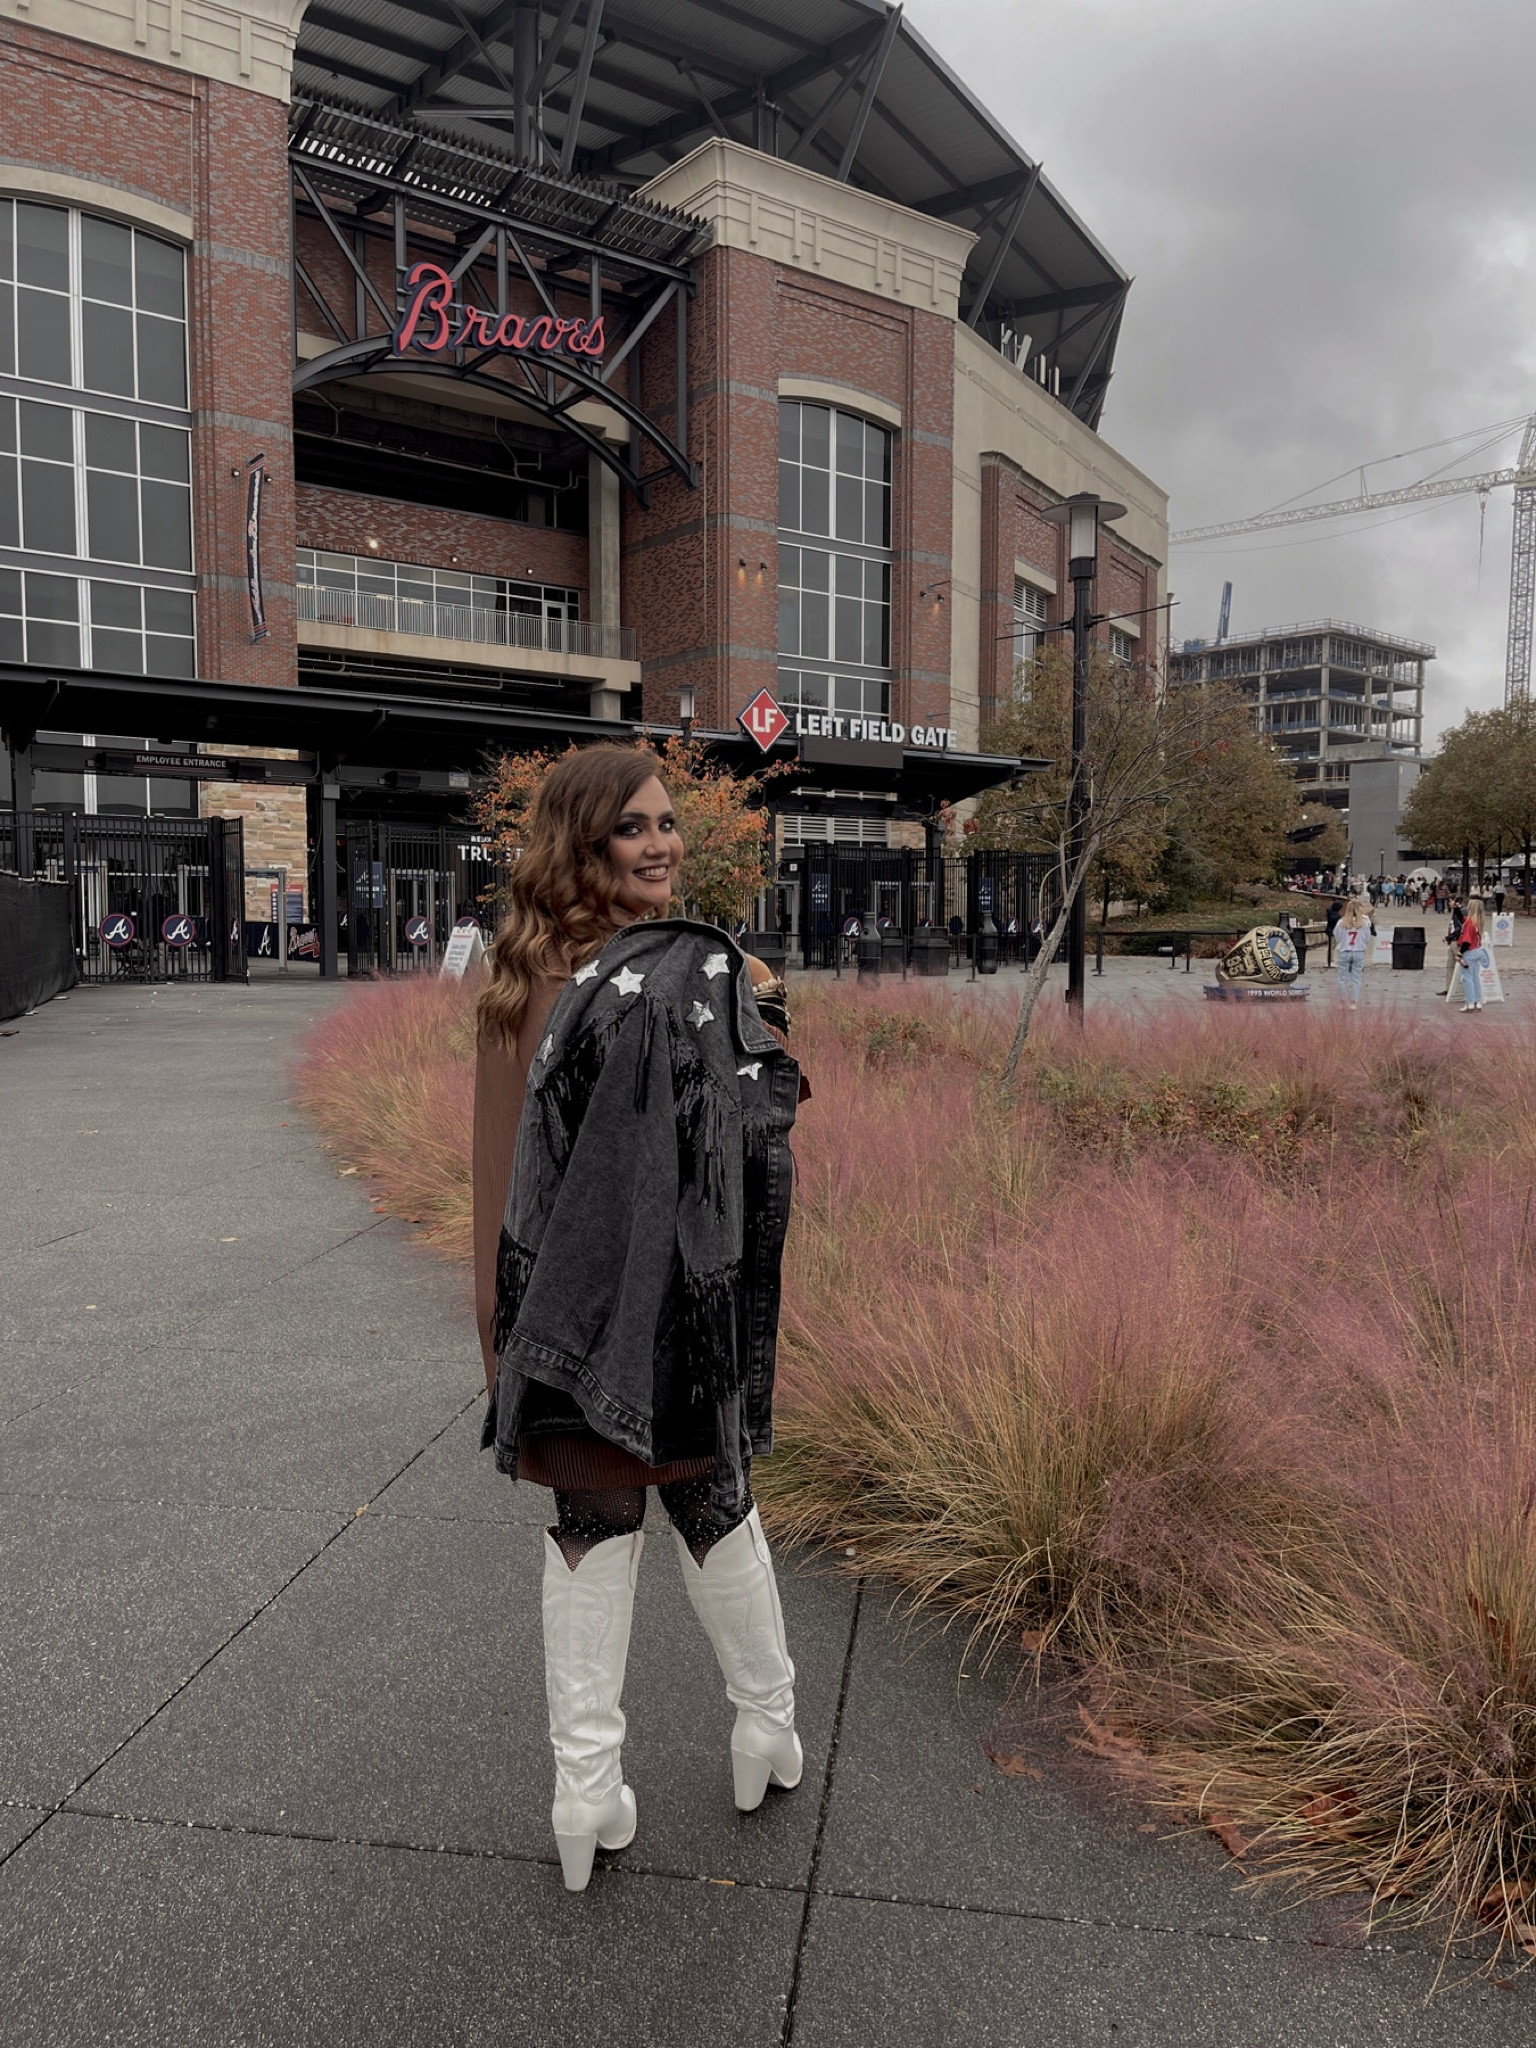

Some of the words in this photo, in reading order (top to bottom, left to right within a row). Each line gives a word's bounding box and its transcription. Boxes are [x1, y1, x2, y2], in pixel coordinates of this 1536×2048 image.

[394, 261, 605, 358] Braves
[752, 707, 777, 734] LF
[796, 713, 845, 738] LEFT
[850, 718, 906, 744] FIELD
[911, 725, 958, 749] GATE
[136, 754, 181, 766] EMPLOYEE
[183, 757, 227, 769] ENTRANCE
[1348, 931, 1358, 945] 7
[1263, 989, 1288, 997] WORLD
